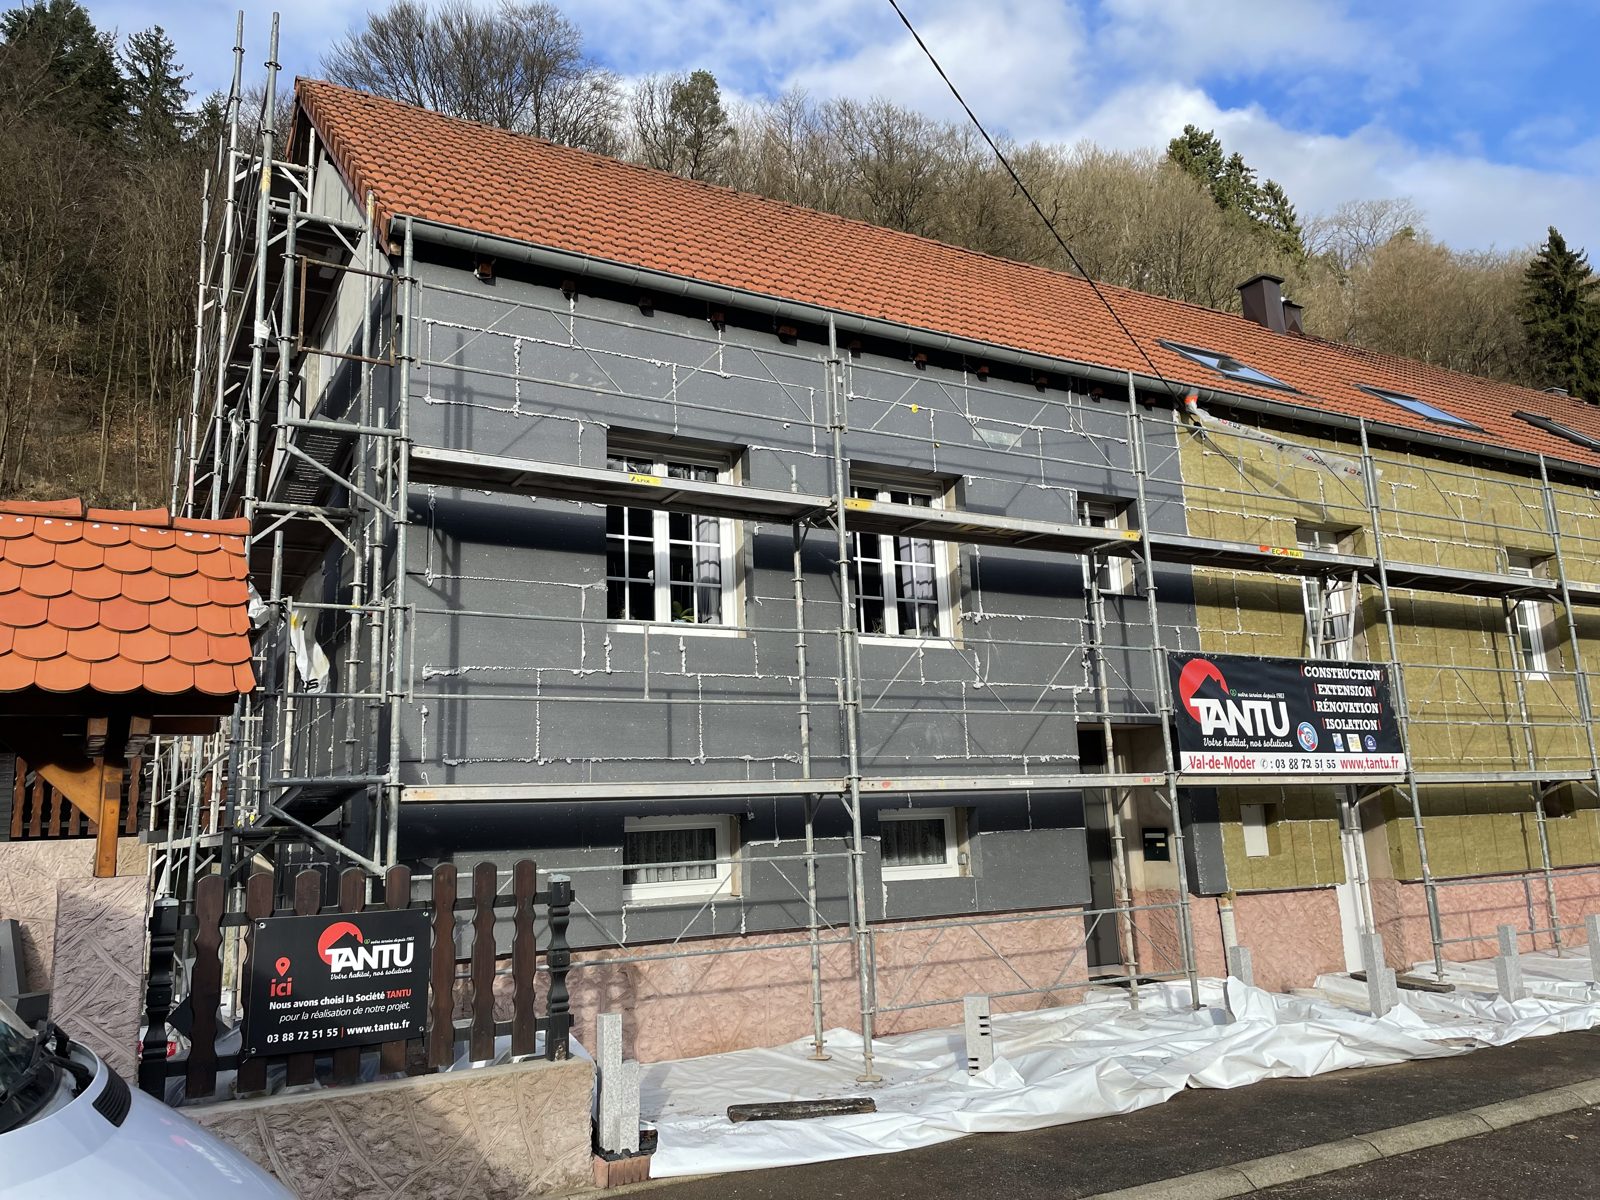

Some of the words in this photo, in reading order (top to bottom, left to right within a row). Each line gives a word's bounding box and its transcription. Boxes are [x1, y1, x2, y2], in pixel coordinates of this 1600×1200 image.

[1271, 548, 1303, 558] ECMAT
[1304, 666, 1380, 681] CONSTRUCTION
[1317, 683, 1373, 697] EXTENSION
[1316, 698, 1379, 714] RÉNOVATION
[1190, 698, 1290, 737] TANTU
[1325, 718, 1378, 731] ISOLATION
[1203, 737, 1223, 747] Votre
[1223, 737, 1249, 749] habitat,
[1250, 740, 1262, 748] nos
[1263, 738, 1294, 748] solutions
[1189, 754, 1256, 770] Val-de-Moder
[1275, 758, 1286, 769] 03
[1288, 758, 1299, 770] 88
[1301, 758, 1312, 769] 72
[1314, 759, 1324, 769] 51
[1326, 759, 1337, 769] 55
[1340, 756, 1399, 770] www.tantu.fr
[324, 942, 414, 973] TANTU
[330, 973, 348, 981] Votre
[385, 967, 413, 976] solutions
[270, 977, 292, 997] ici
[269, 1001, 292, 1010] Nous
[293, 999, 319, 1008] avons
[320, 994, 344, 1006] choisi
[346, 994, 354, 1003] la
[355, 991, 386, 1002] Société
[386, 988, 412, 999] TANTU
[278, 1013, 301, 1025] pour
[301, 1011, 310, 1020] la
[310, 1007, 351, 1019] réalisation
[352, 1006, 364, 1015] de
[364, 1004, 386, 1014] notre
[386, 1001, 411, 1014] projet.
[266, 1034, 280, 1044] 03
[282, 1032, 294, 1042] 88
[297, 1030, 310, 1040] 72
[312, 1029, 324, 1039] 51
[326, 1028, 338, 1038] 55
[346, 1019, 411, 1035] www.tantu.fr
